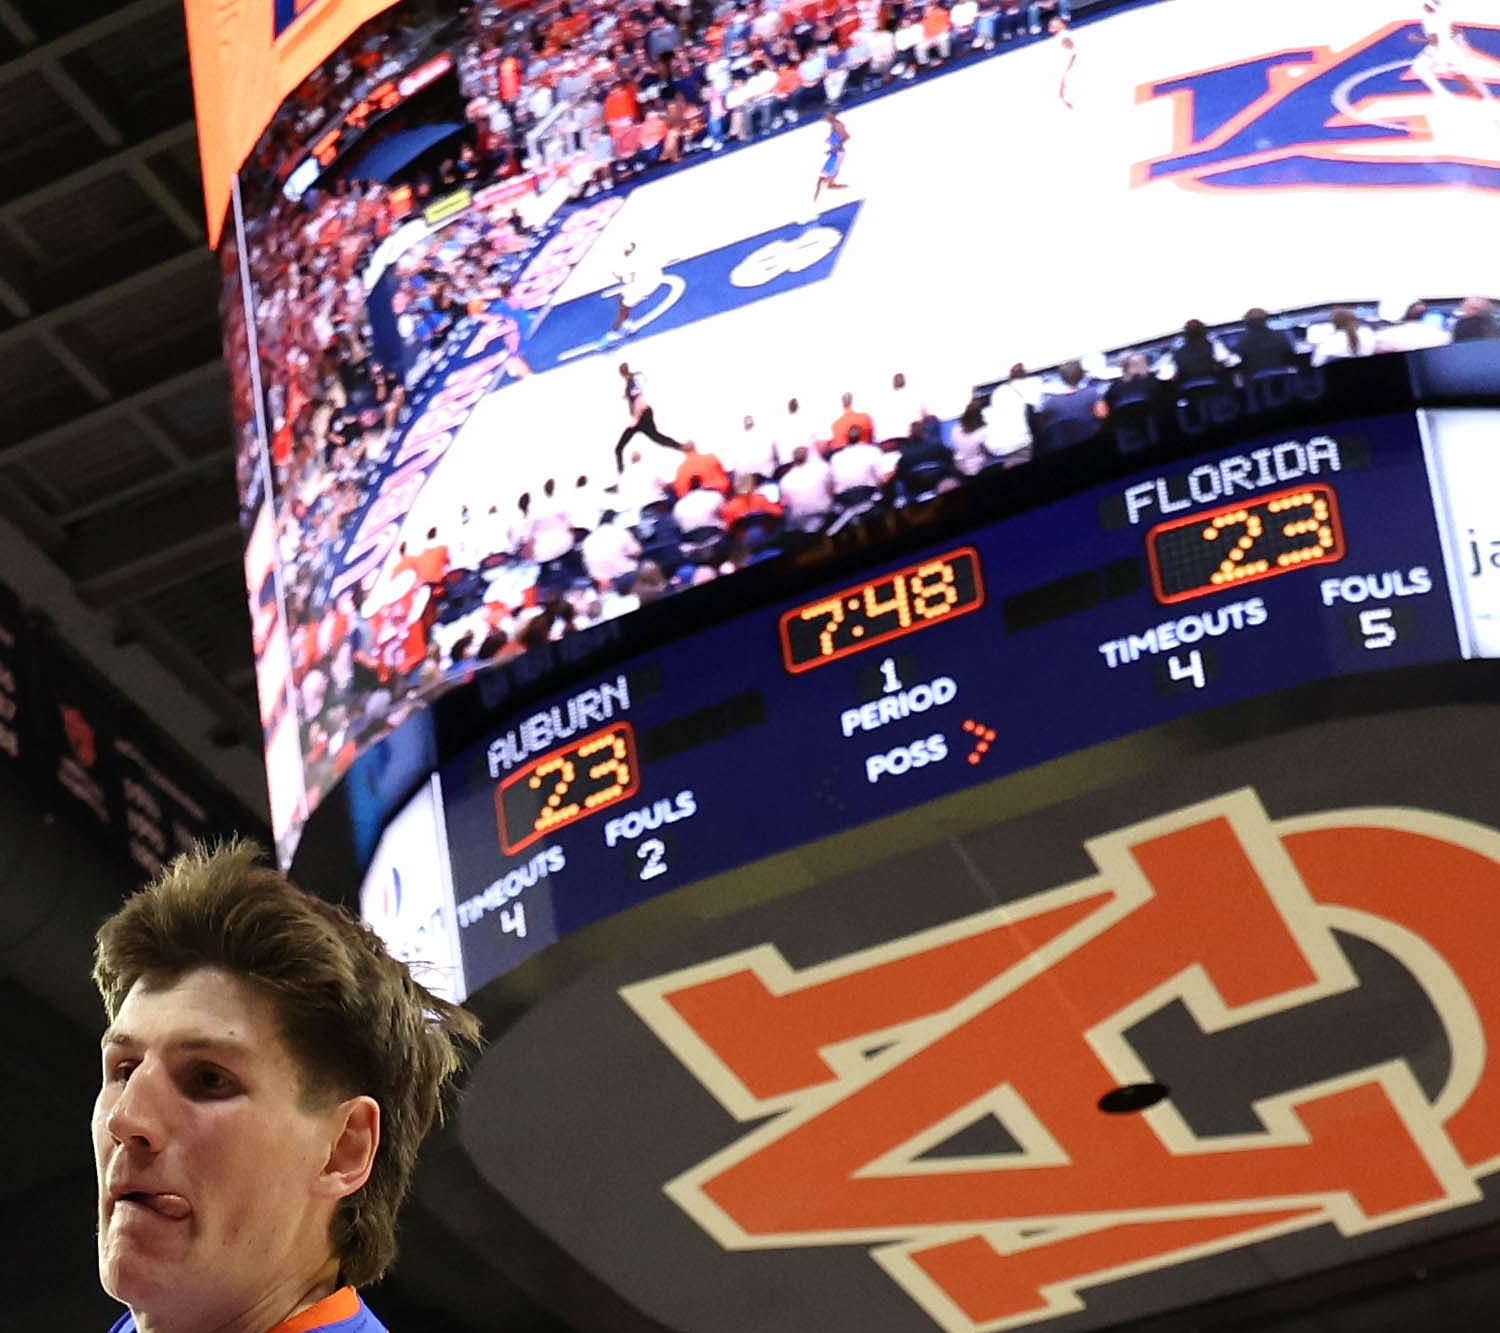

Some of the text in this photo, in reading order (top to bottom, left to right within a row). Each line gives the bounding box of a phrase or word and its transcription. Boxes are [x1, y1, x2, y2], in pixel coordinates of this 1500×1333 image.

[1124, 436, 1341, 524] FLORIDA
[1203, 493, 1334, 585] 23
[800, 561, 957, 655] 7:48
[1320, 566, 1433, 606] FOULS
[1099, 597, 1269, 668] TIMEOUTS
[1359, 608, 1397, 649] 5
[880, 657, 901, 693] 1
[1167, 650, 1206, 688] 4
[487, 675, 630, 778] AUBURN
[840, 676, 958, 737] PERIOD
[527, 733, 630, 831] 23
[866, 734, 949, 783] POSS
[605, 790, 697, 847] FOULS
[637, 838, 668, 880] 2
[501, 903, 527, 938] 4
